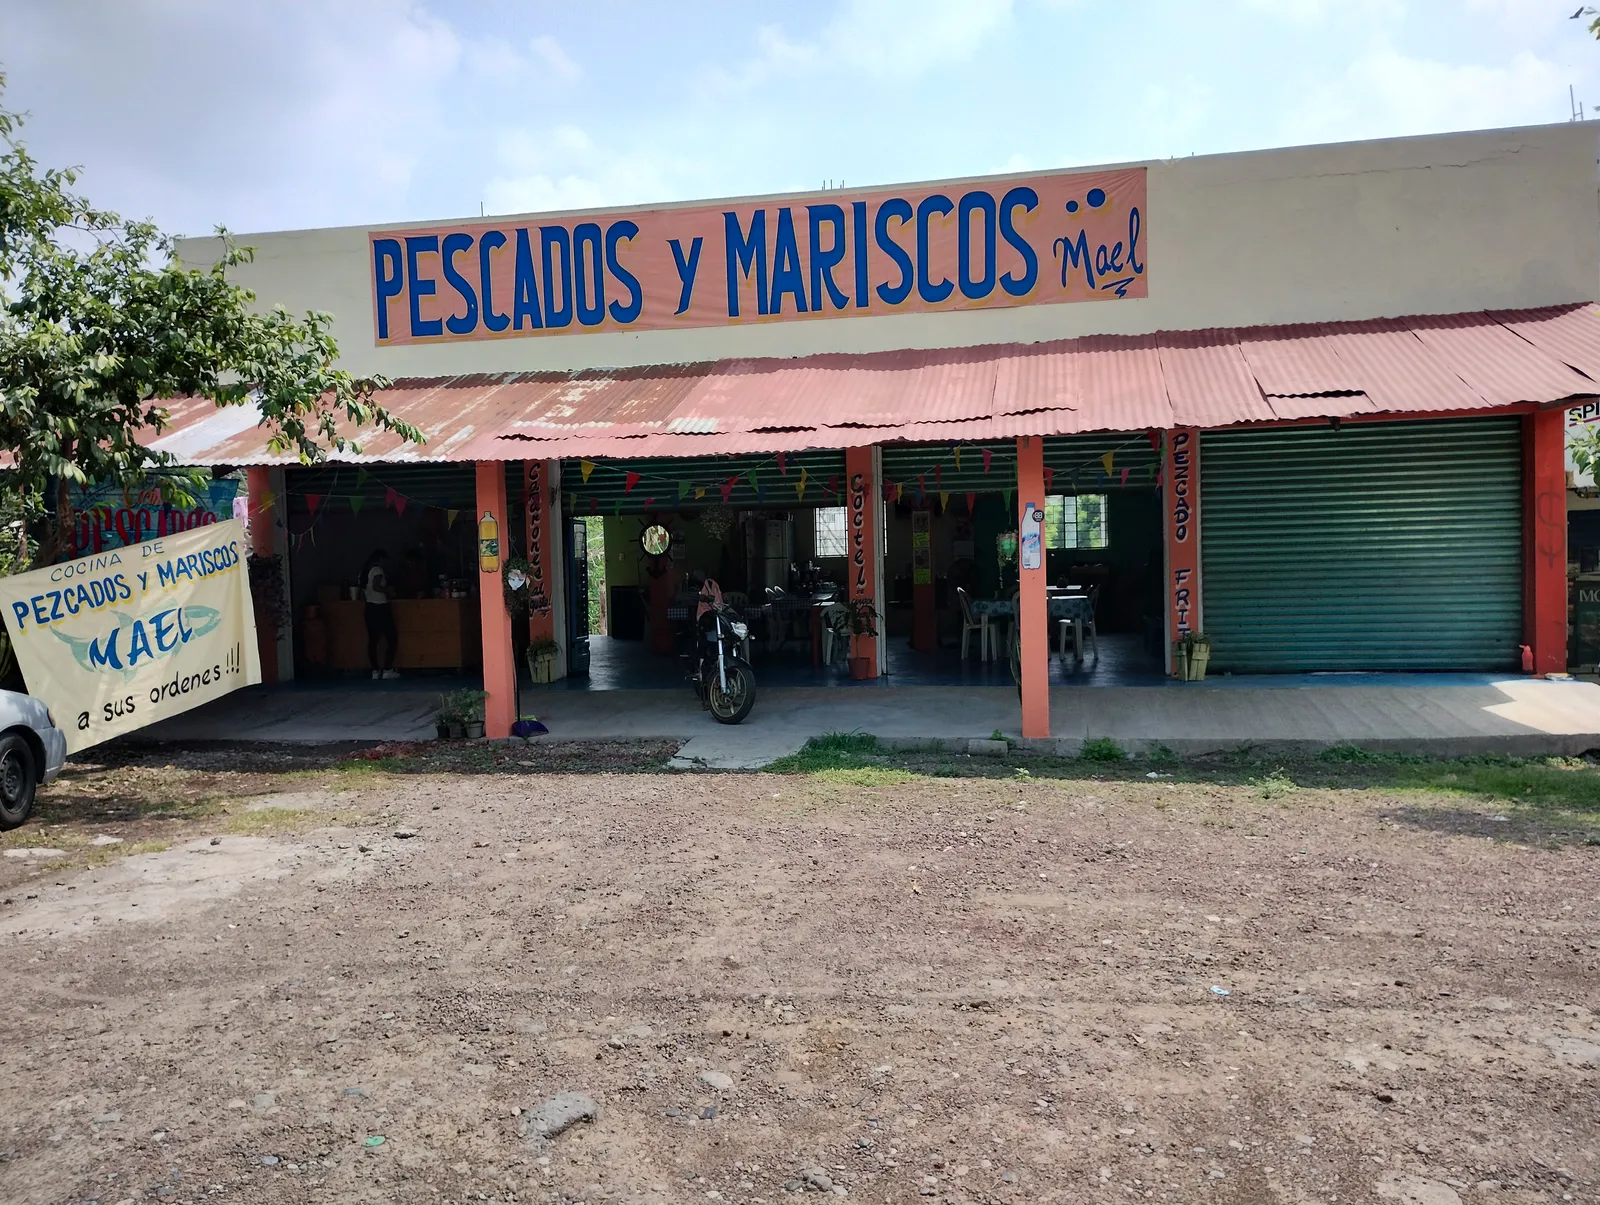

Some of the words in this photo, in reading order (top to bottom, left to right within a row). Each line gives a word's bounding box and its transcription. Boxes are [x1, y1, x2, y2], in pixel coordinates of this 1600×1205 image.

[372, 220, 642, 338] PESCADOS
[723, 187, 1039, 317] MARISCOS
[1053, 207, 1143, 289] Mael
[1172, 432, 1190, 541] PEZCADO
[50, 553, 122, 582] COCINA
[142, 541, 165, 557] DE
[851, 474, 866, 586] Coctel
[12, 574, 131, 629] PEZCADOS
[156, 541, 239, 587] MARISCOS
[1175, 569, 1191, 644] FRIT
[89, 608, 192, 670] MAEL
[78, 711, 90, 730] a
[104, 696, 136, 722] sus
